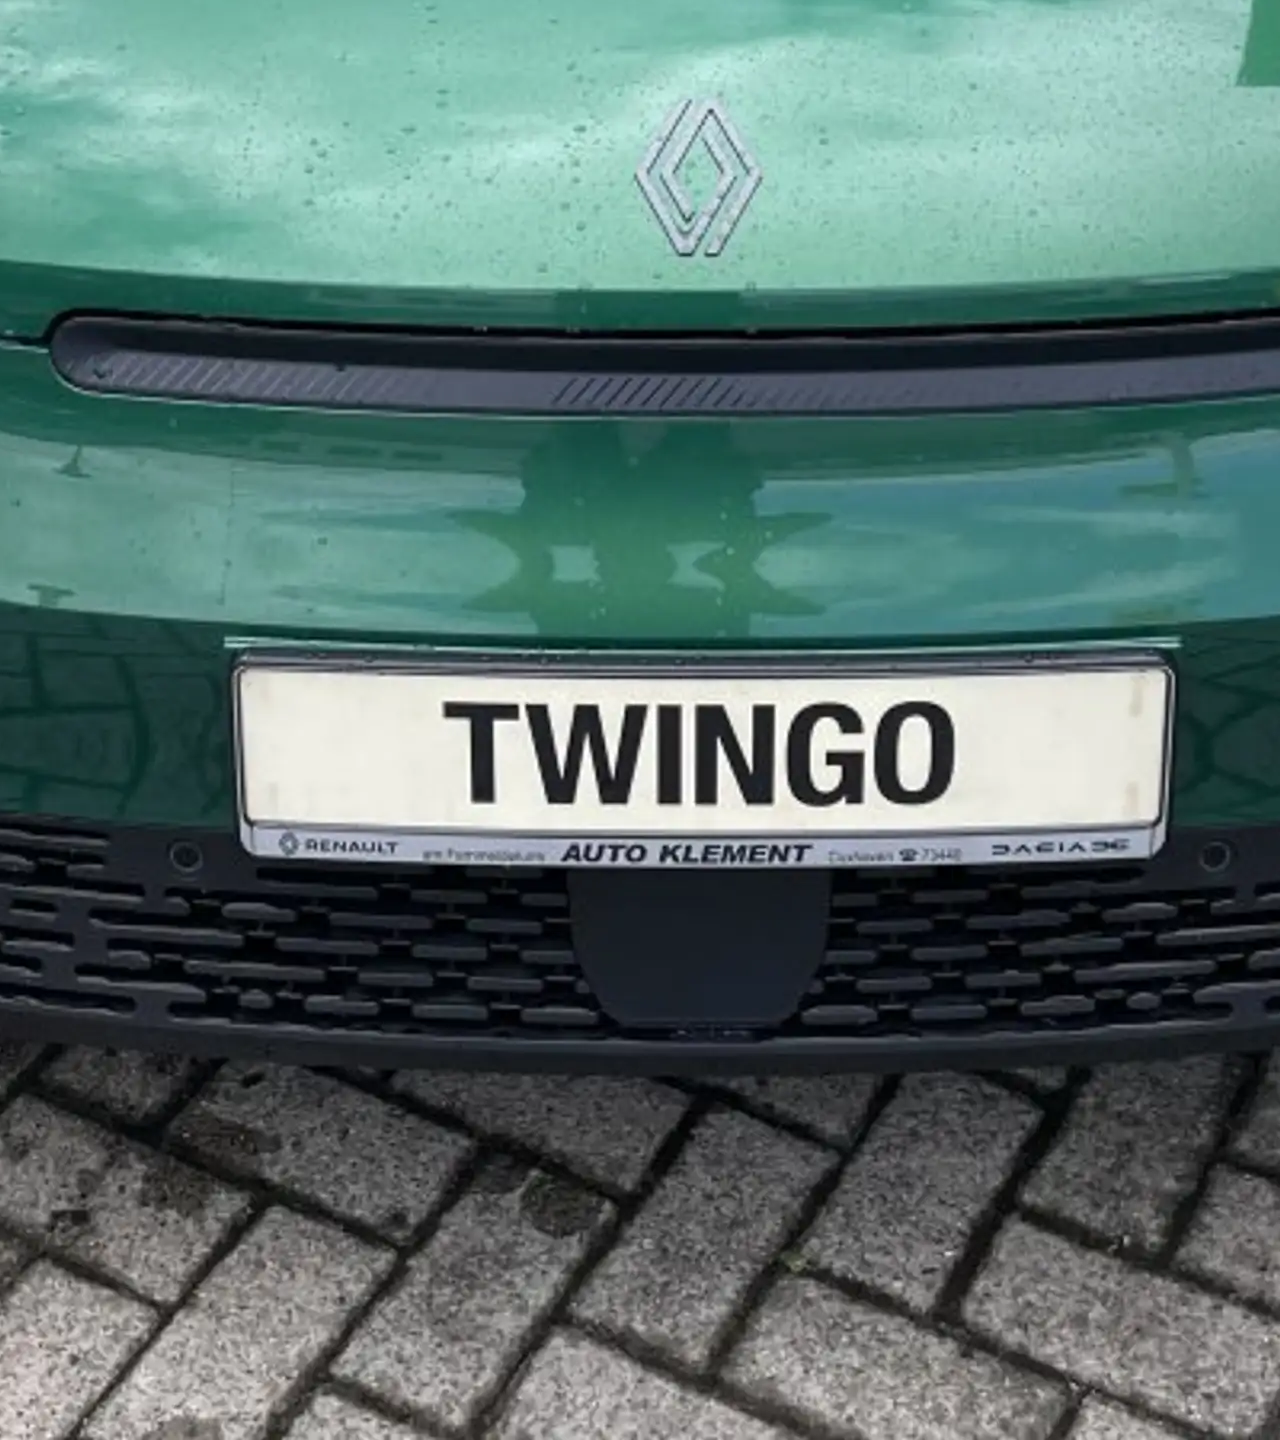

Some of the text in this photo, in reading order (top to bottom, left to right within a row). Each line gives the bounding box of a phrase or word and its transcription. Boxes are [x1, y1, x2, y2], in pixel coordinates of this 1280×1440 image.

[442, 700, 955, 807] TWINGO
[304, 838, 399, 855] RENAULT
[561, 843, 648, 863] AUTO
[658, 843, 813, 864] KLEMENT
